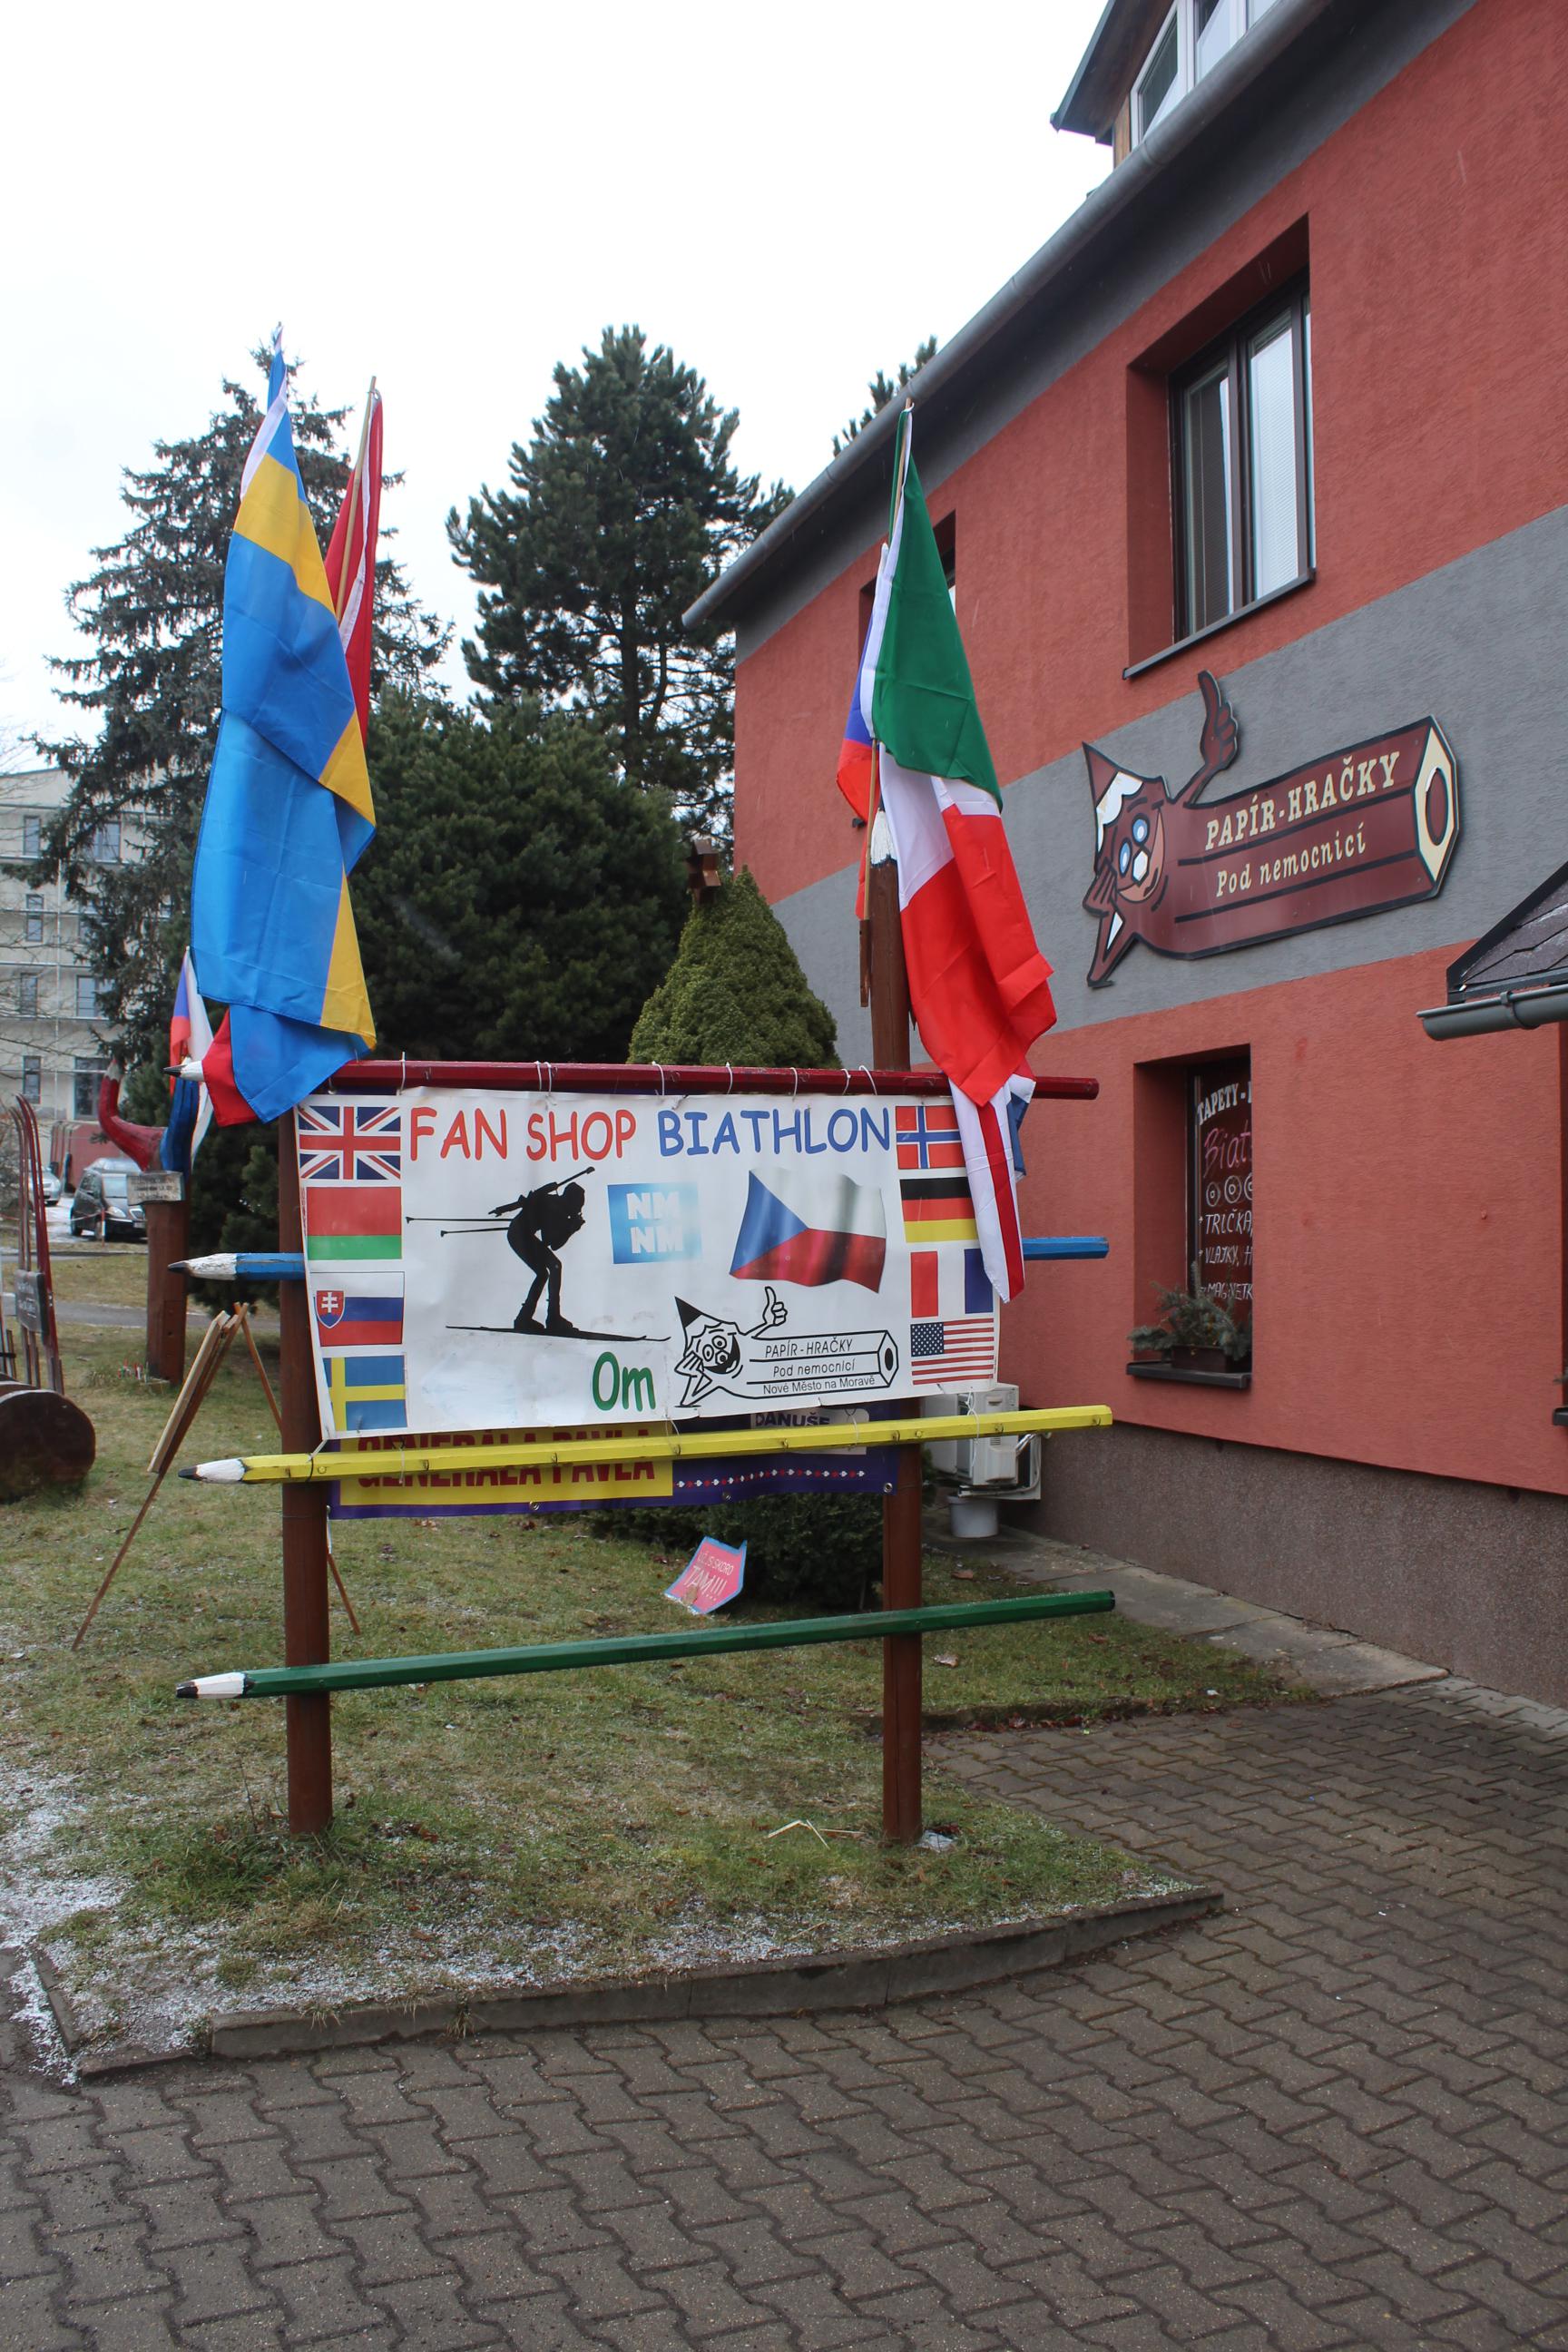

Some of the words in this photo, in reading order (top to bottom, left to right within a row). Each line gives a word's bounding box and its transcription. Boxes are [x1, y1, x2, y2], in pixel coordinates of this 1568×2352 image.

[1216, 863, 1252, 898] Pod
[1259, 821, 1367, 886] nemocnicí
[410, 1106, 508, 1161] FAN
[525, 1109, 637, 1162] SHOP
[657, 1107, 892, 1157] BIATHLON
[626, 1191, 679, 1220] NM
[631, 1225, 683, 1254] NM
[773, 1365, 794, 1377] Pod
[763, 1384, 789, 1395] Nové
[792, 1379, 822, 1393] Město
